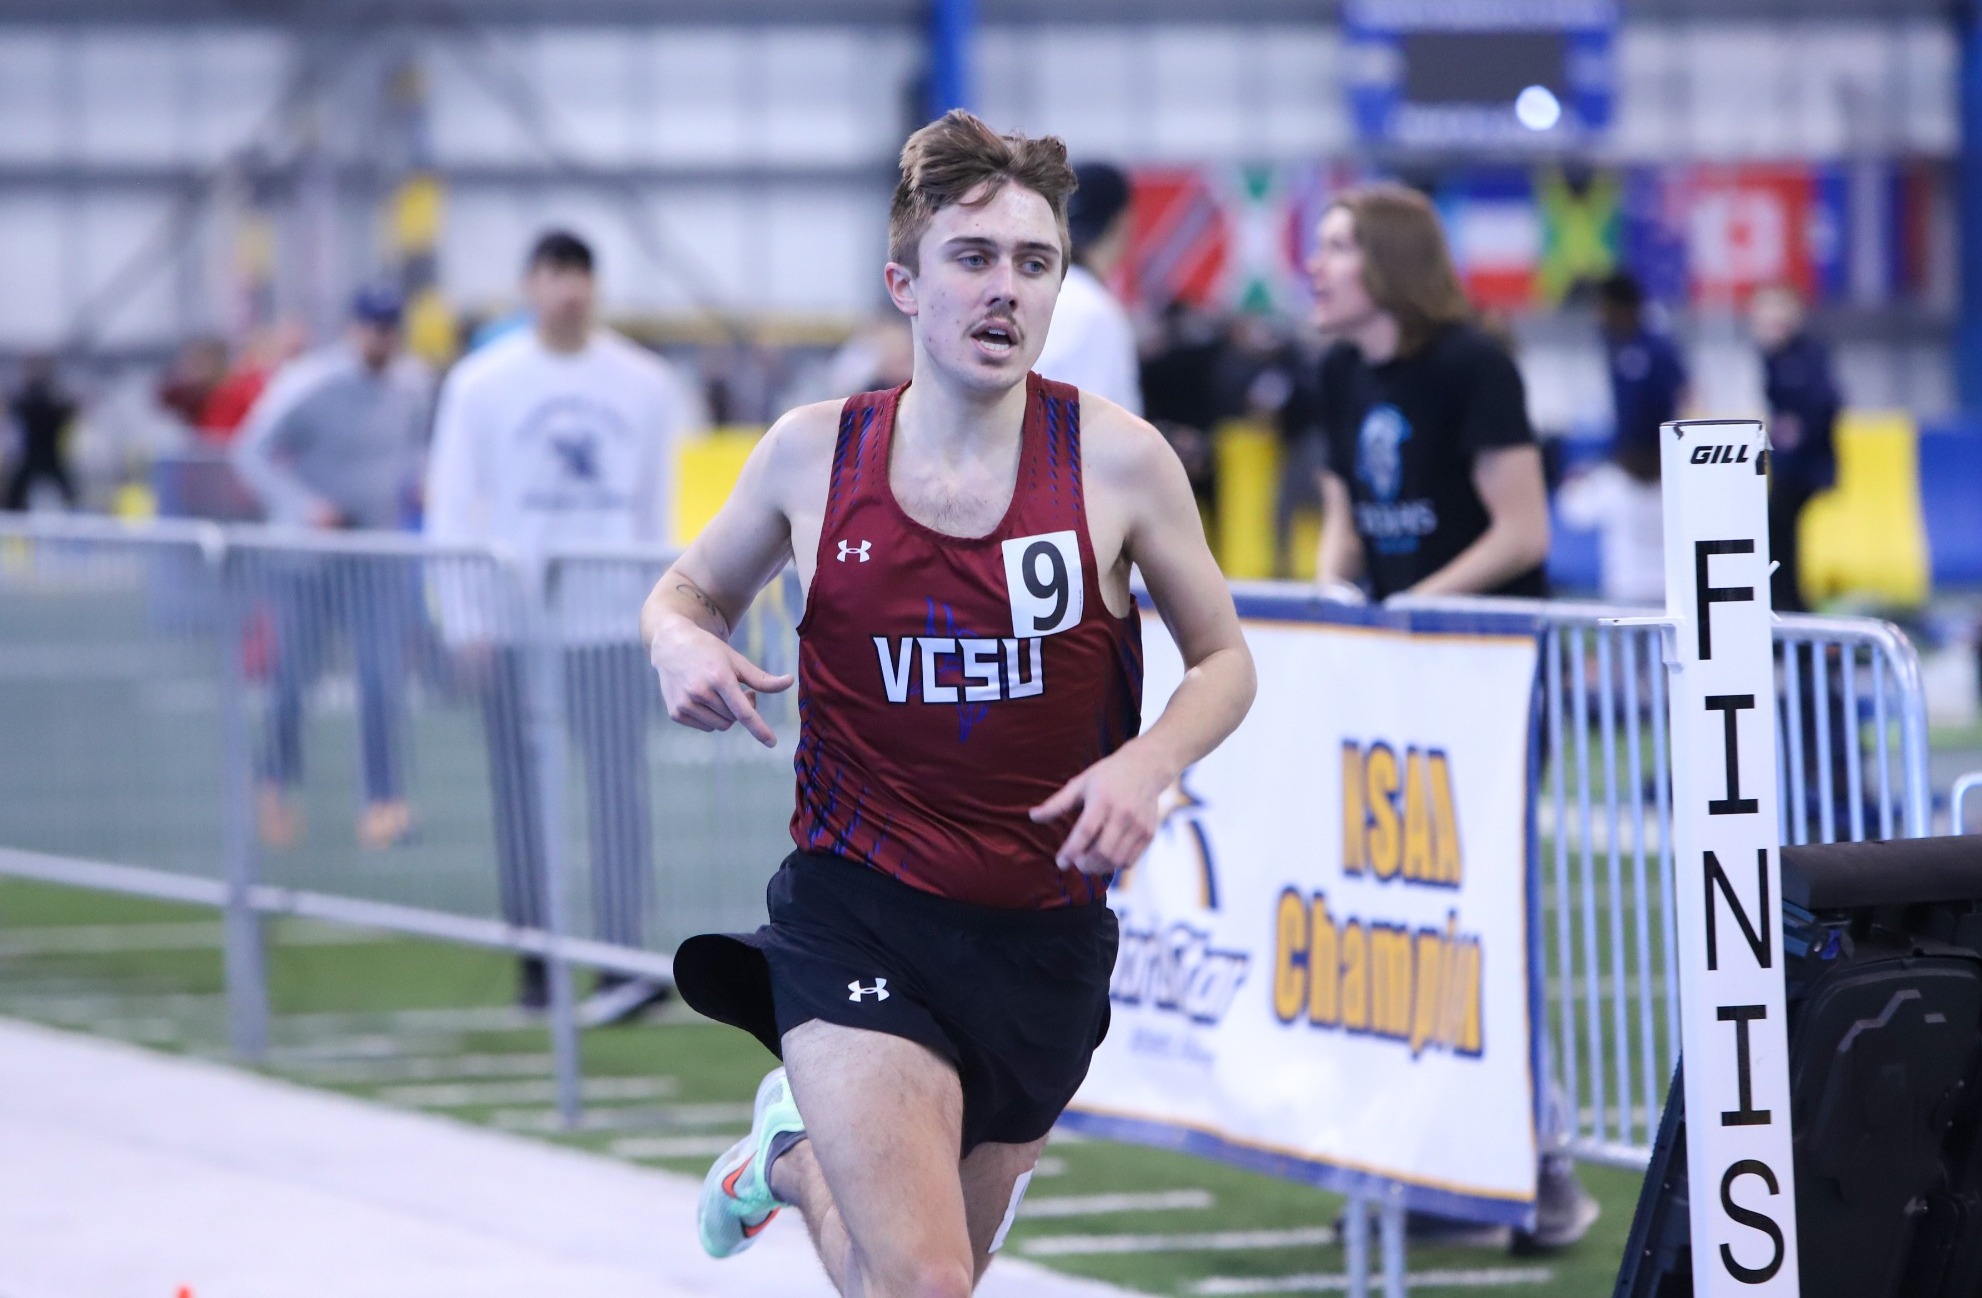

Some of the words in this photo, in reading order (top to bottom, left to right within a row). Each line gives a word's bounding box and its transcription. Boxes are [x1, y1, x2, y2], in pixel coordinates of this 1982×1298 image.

[1690, 444, 1749, 464] GILL
[1021, 540, 1069, 631] 9
[872, 636, 1044, 704] VCSU
